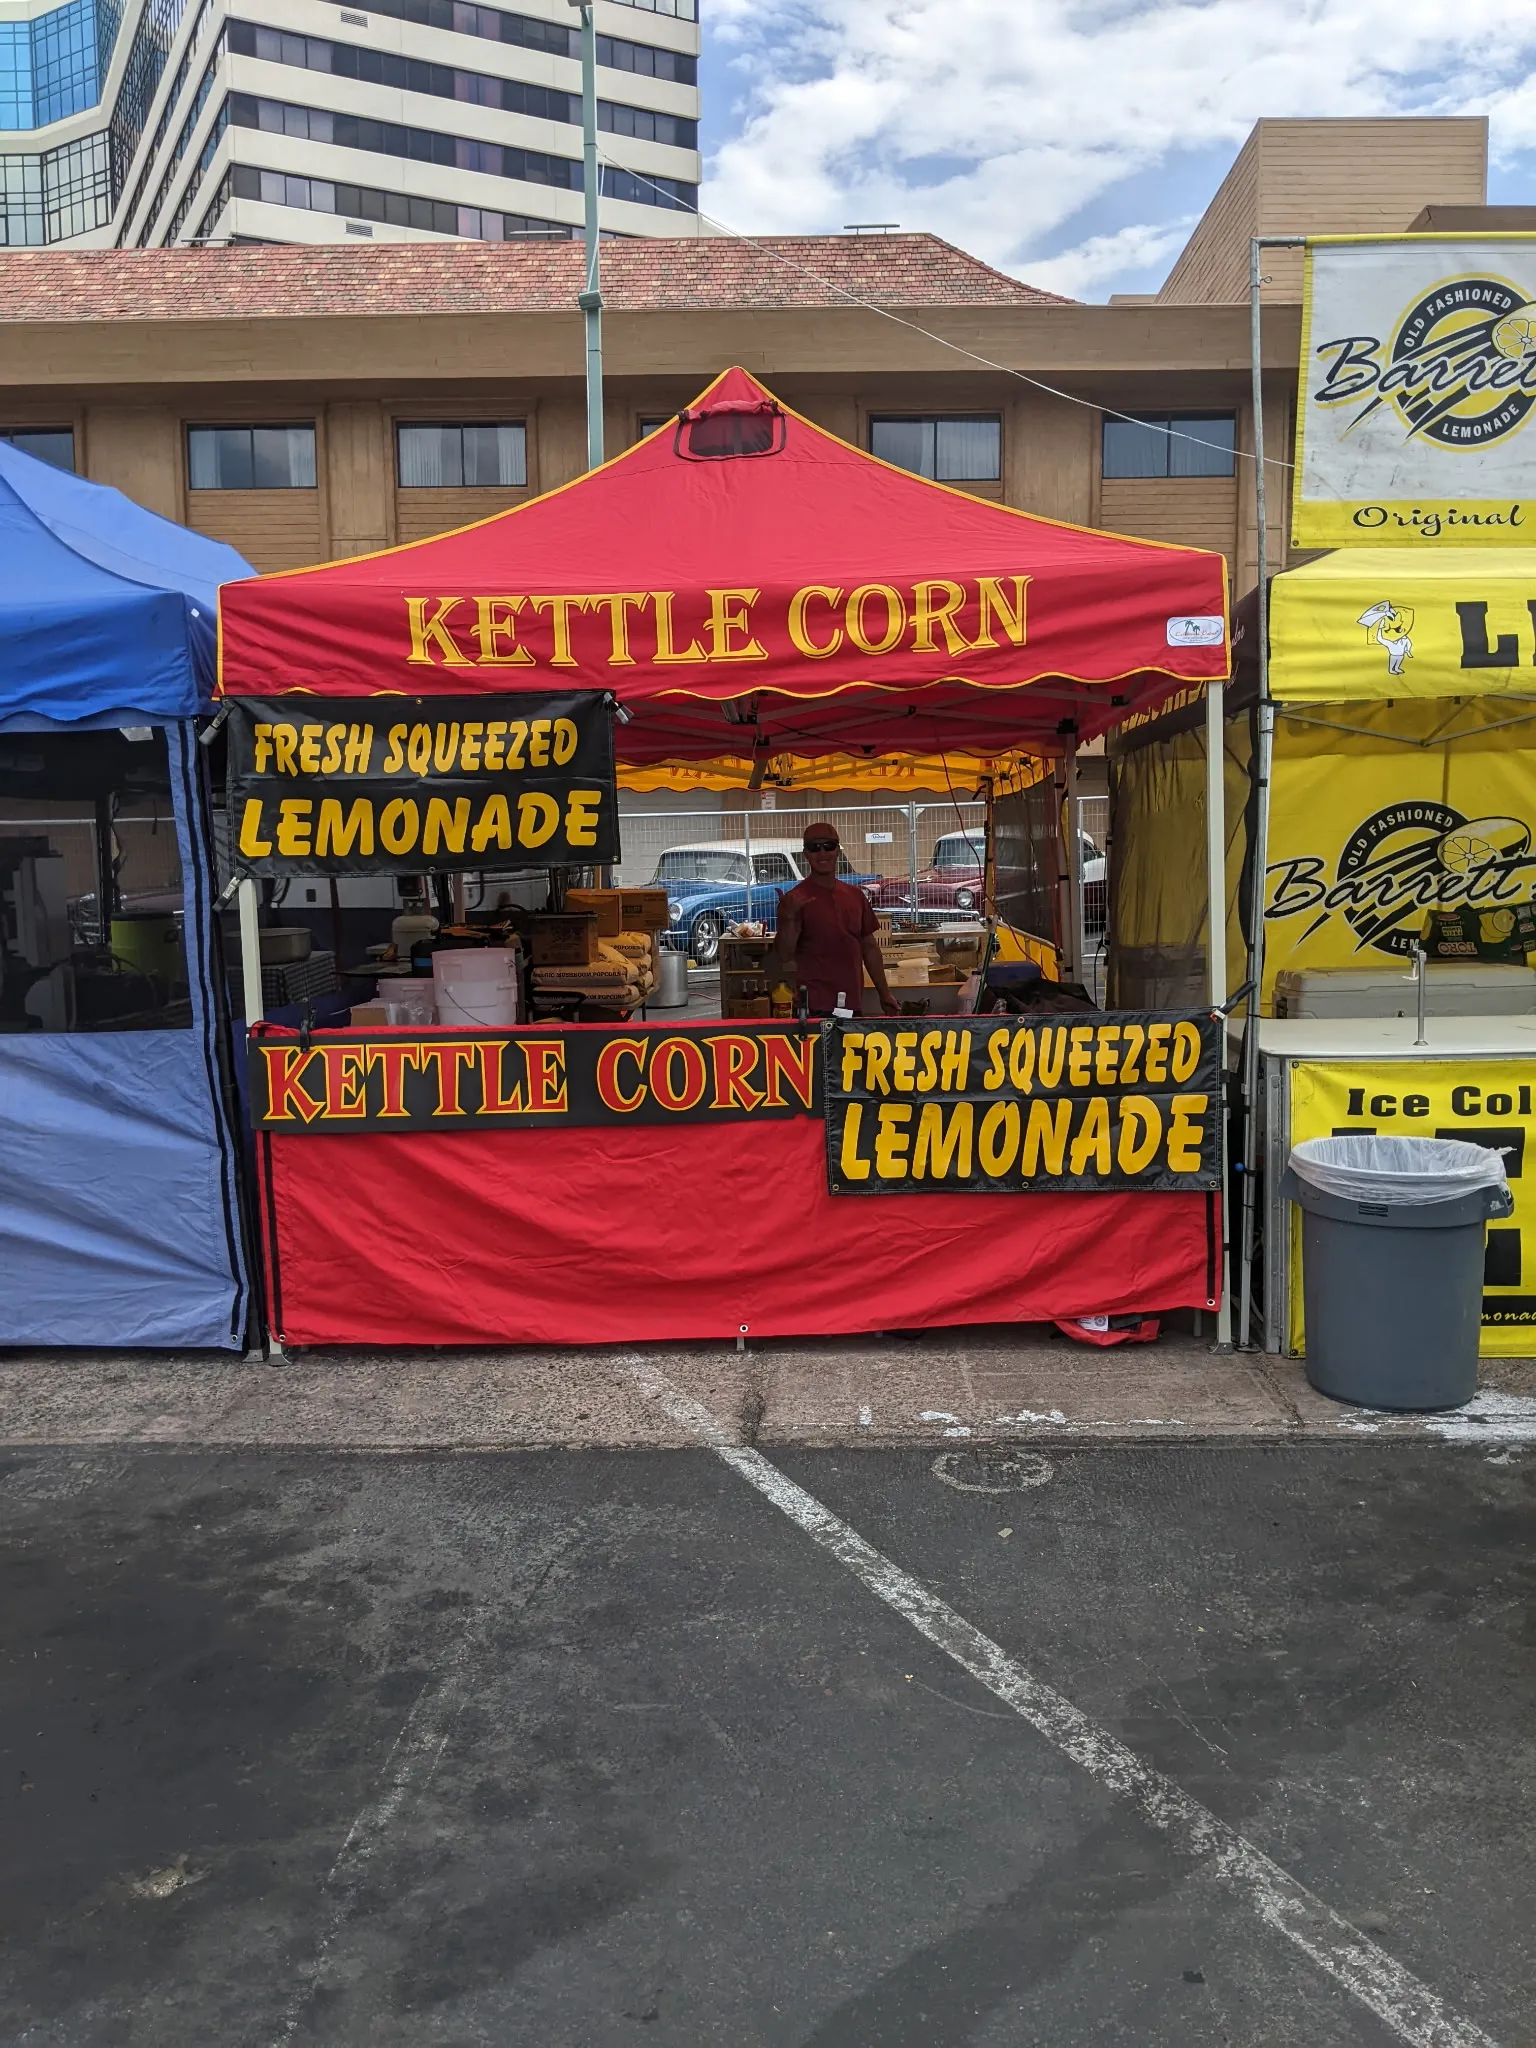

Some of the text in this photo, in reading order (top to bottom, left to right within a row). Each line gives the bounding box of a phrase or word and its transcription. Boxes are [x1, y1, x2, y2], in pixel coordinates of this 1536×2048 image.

[1404, 288, 1512, 347] OLD FASHIONED
[1442, 403, 1520, 438] LEMONADE
[1352, 504, 1527, 537] Original
[404, 575, 1033, 667] KETTLE CORN
[1455, 600, 1536, 669] L
[254, 717, 578, 778] FRESH SQUEEZED
[239, 790, 602, 858] LEMONADE
[1348, 808, 1453, 866] OLD FASHIONED
[1264, 853, 1536, 918] Barrett
[1438, 941, 1478, 954] TORO
[258, 1034, 820, 1124] KETTLE CORN
[842, 1021, 1202, 1096] FRESH SQUEEZED
[1347, 1085, 1532, 1118] Ice Col
[840, 1094, 1209, 1180] LEMONADE
